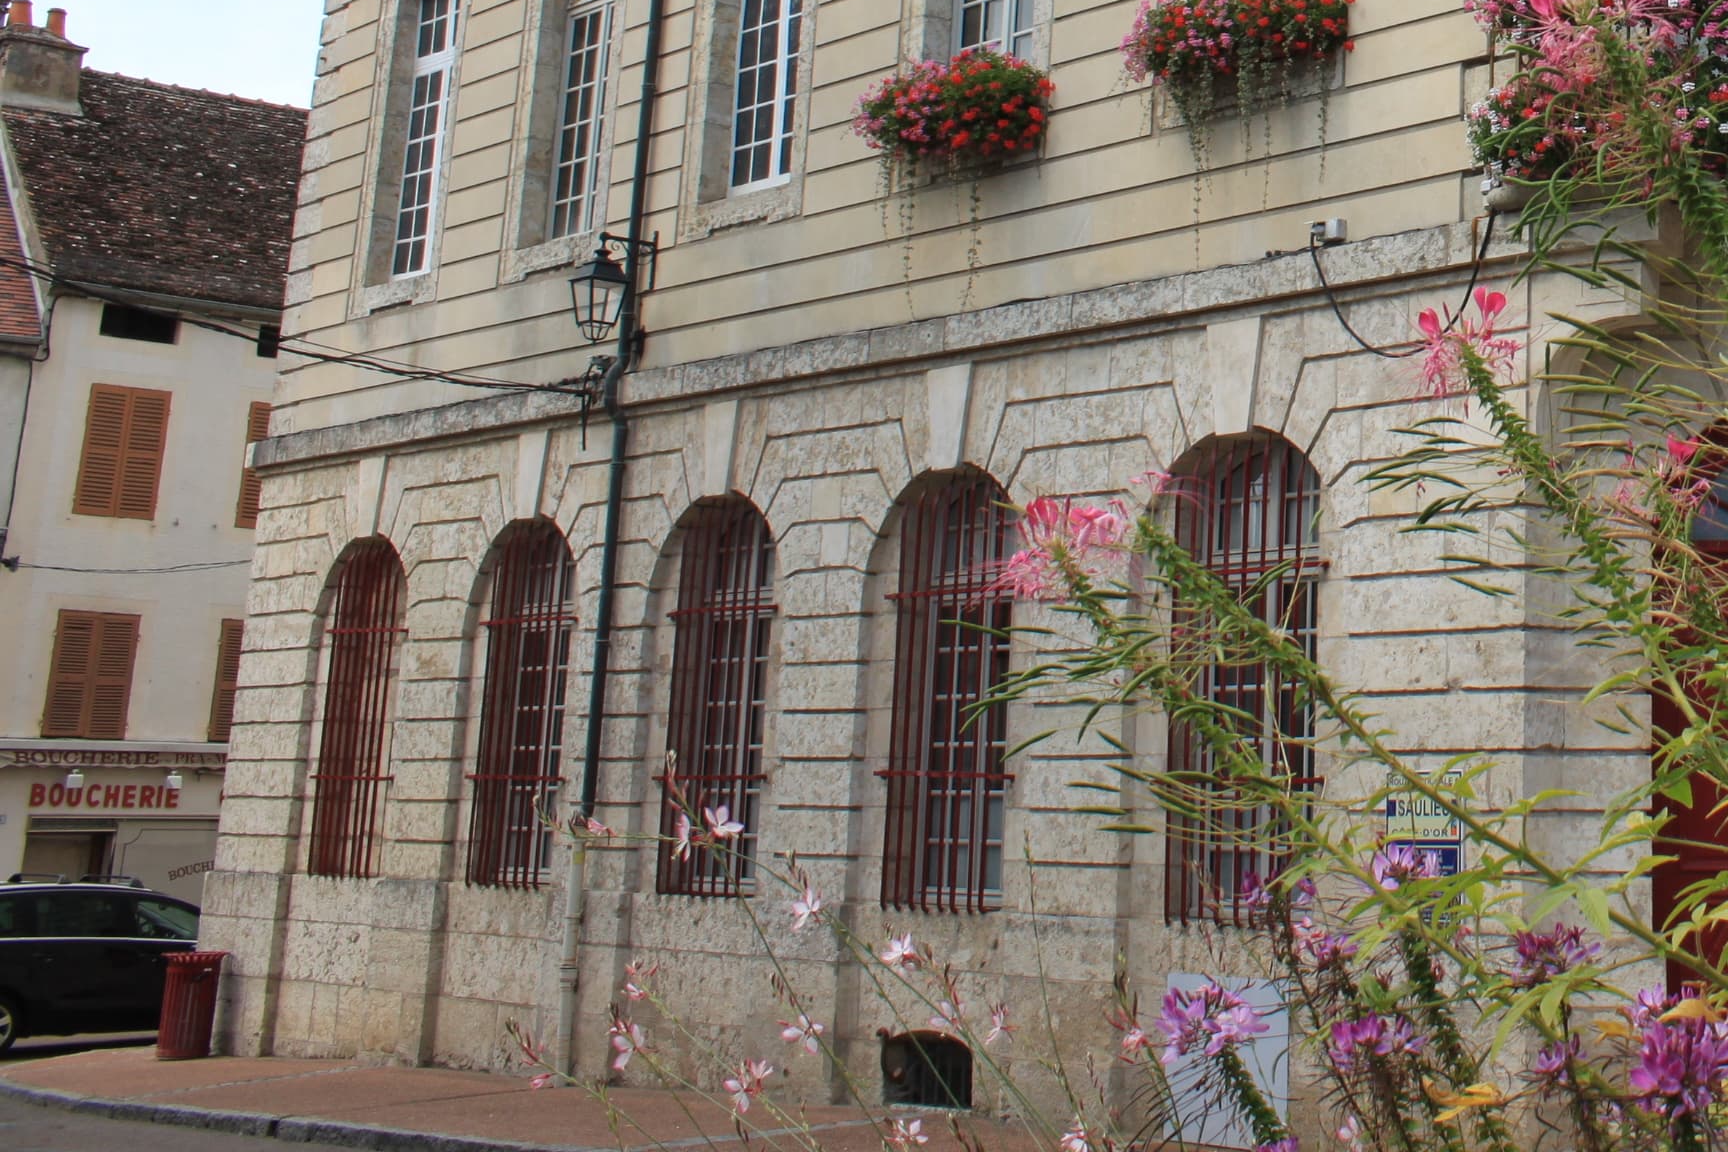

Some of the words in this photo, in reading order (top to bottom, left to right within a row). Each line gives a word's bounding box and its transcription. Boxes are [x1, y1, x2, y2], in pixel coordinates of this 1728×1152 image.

[14, 751, 160, 765] BOUCHERIE
[29, 783, 179, 809] BOUCHERIE
[1397, 799, 1450, 817] SAULIEU
